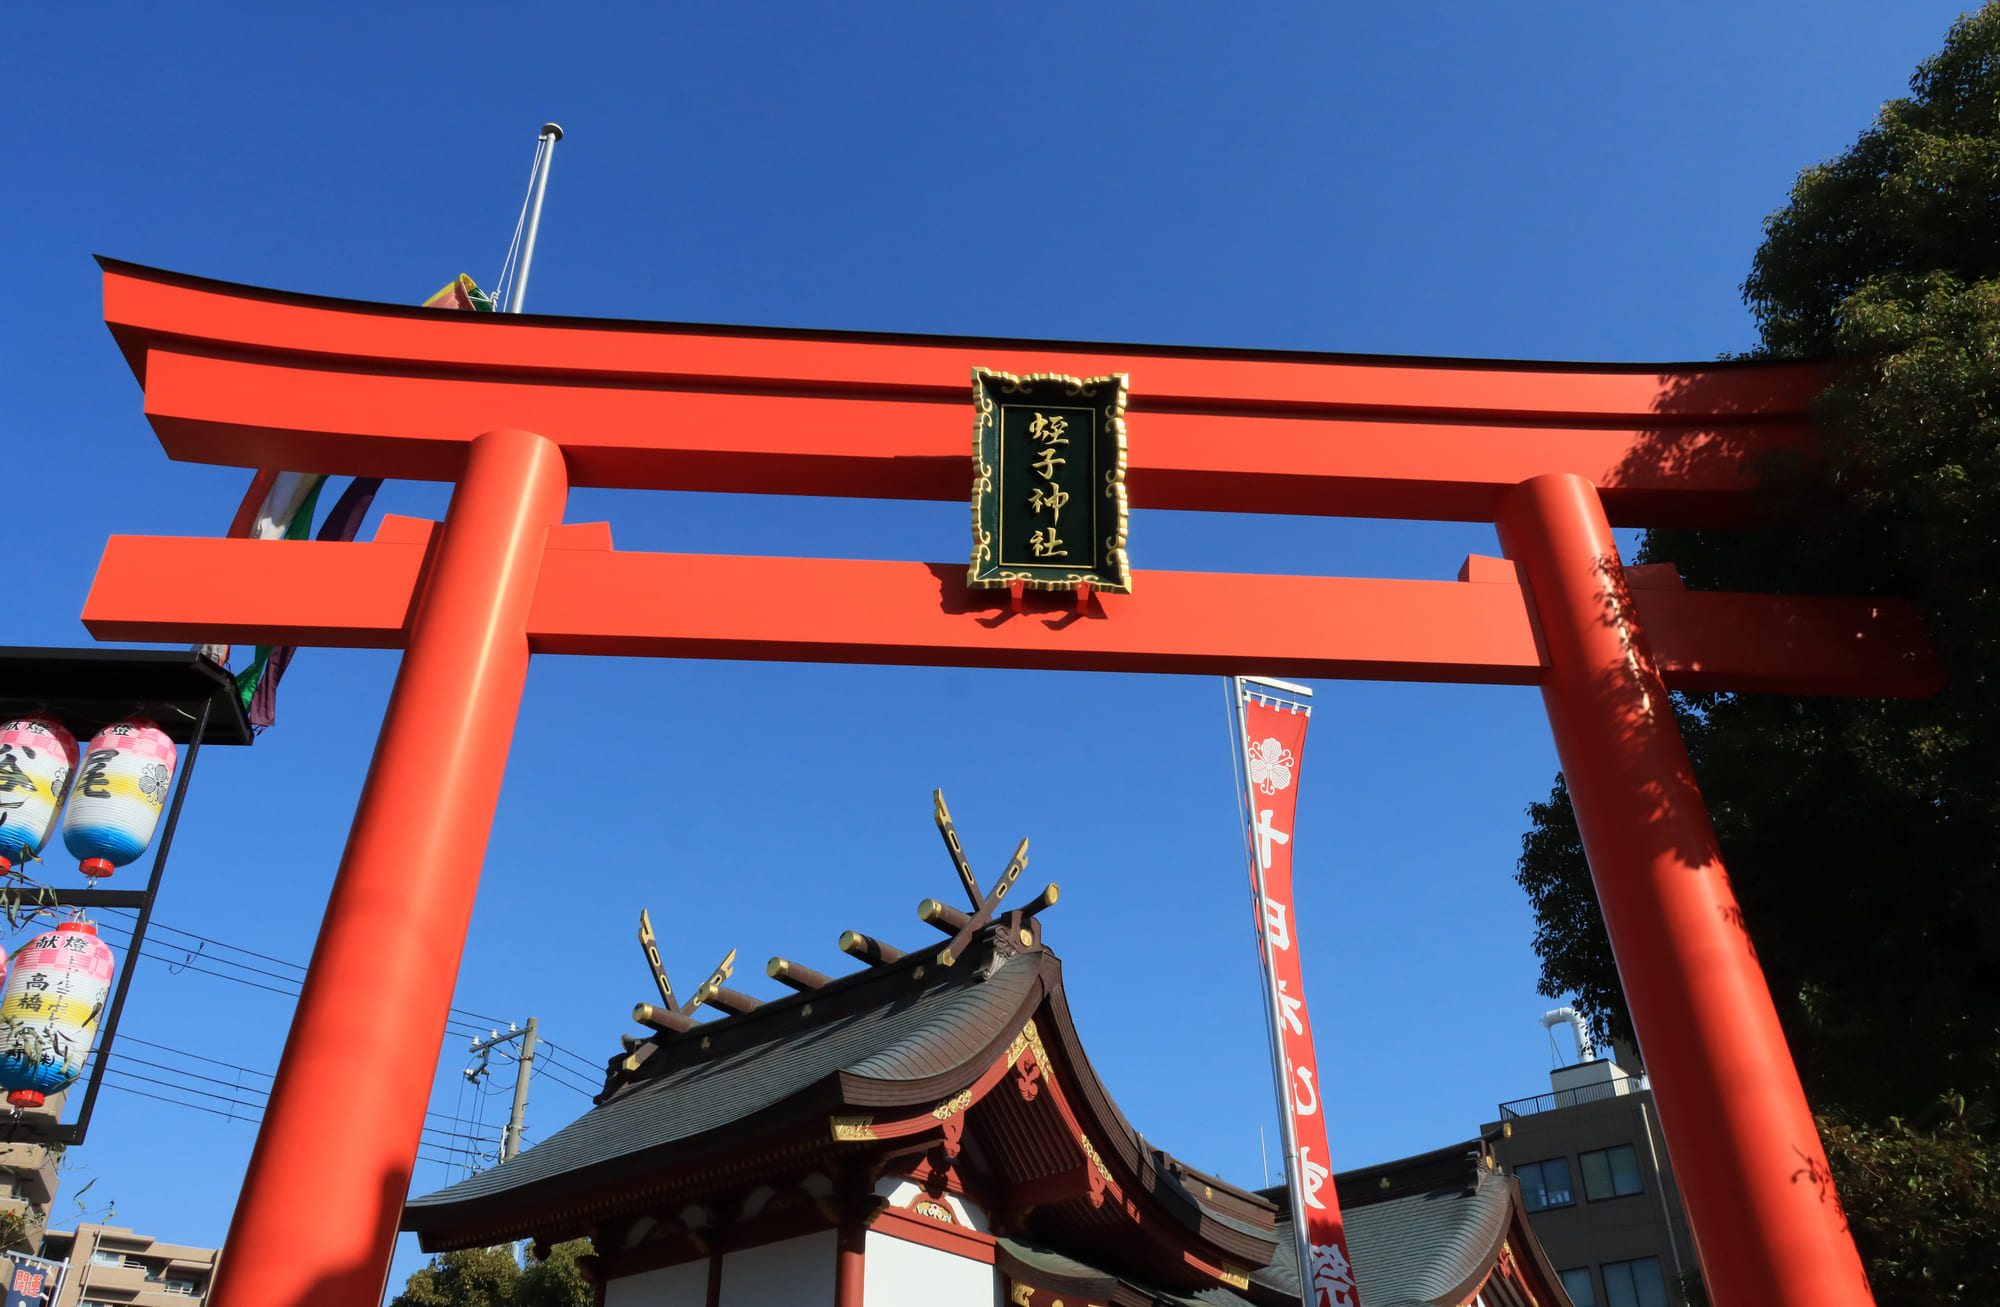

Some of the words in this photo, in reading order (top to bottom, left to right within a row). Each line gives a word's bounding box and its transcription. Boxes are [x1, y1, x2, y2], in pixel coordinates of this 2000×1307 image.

[1028, 412, 1070, 557] 蛭子神社
[34, 935, 89, 954] 献燈
[14, 1269, 43, 1298] 開運
